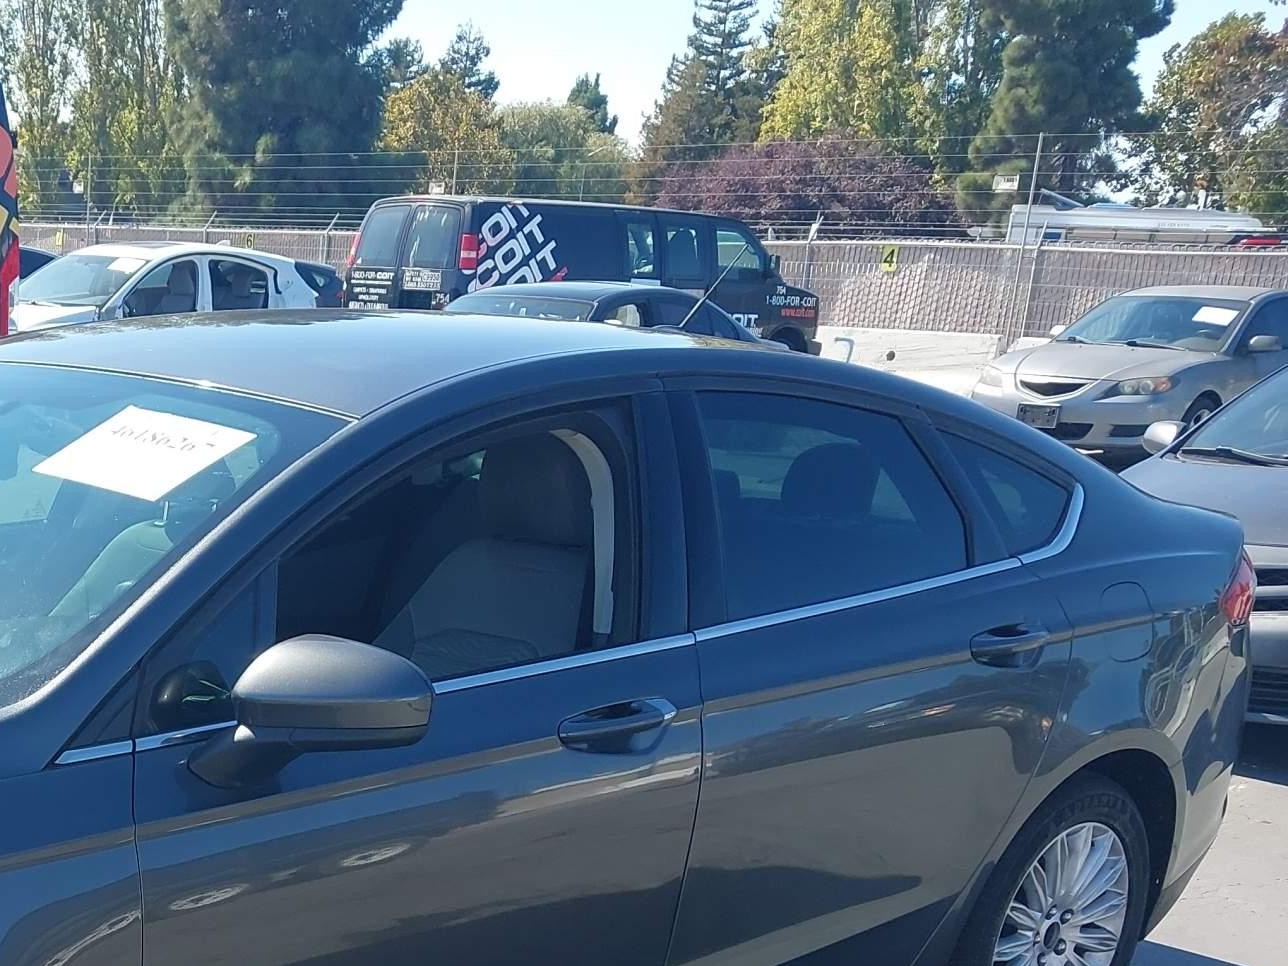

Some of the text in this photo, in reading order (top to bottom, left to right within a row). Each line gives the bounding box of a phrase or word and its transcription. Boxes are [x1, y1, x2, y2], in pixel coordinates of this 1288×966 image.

[246, 234, 254, 249] 6
[883, 249, 895, 267] 4
[776, 286, 787, 295] 754
